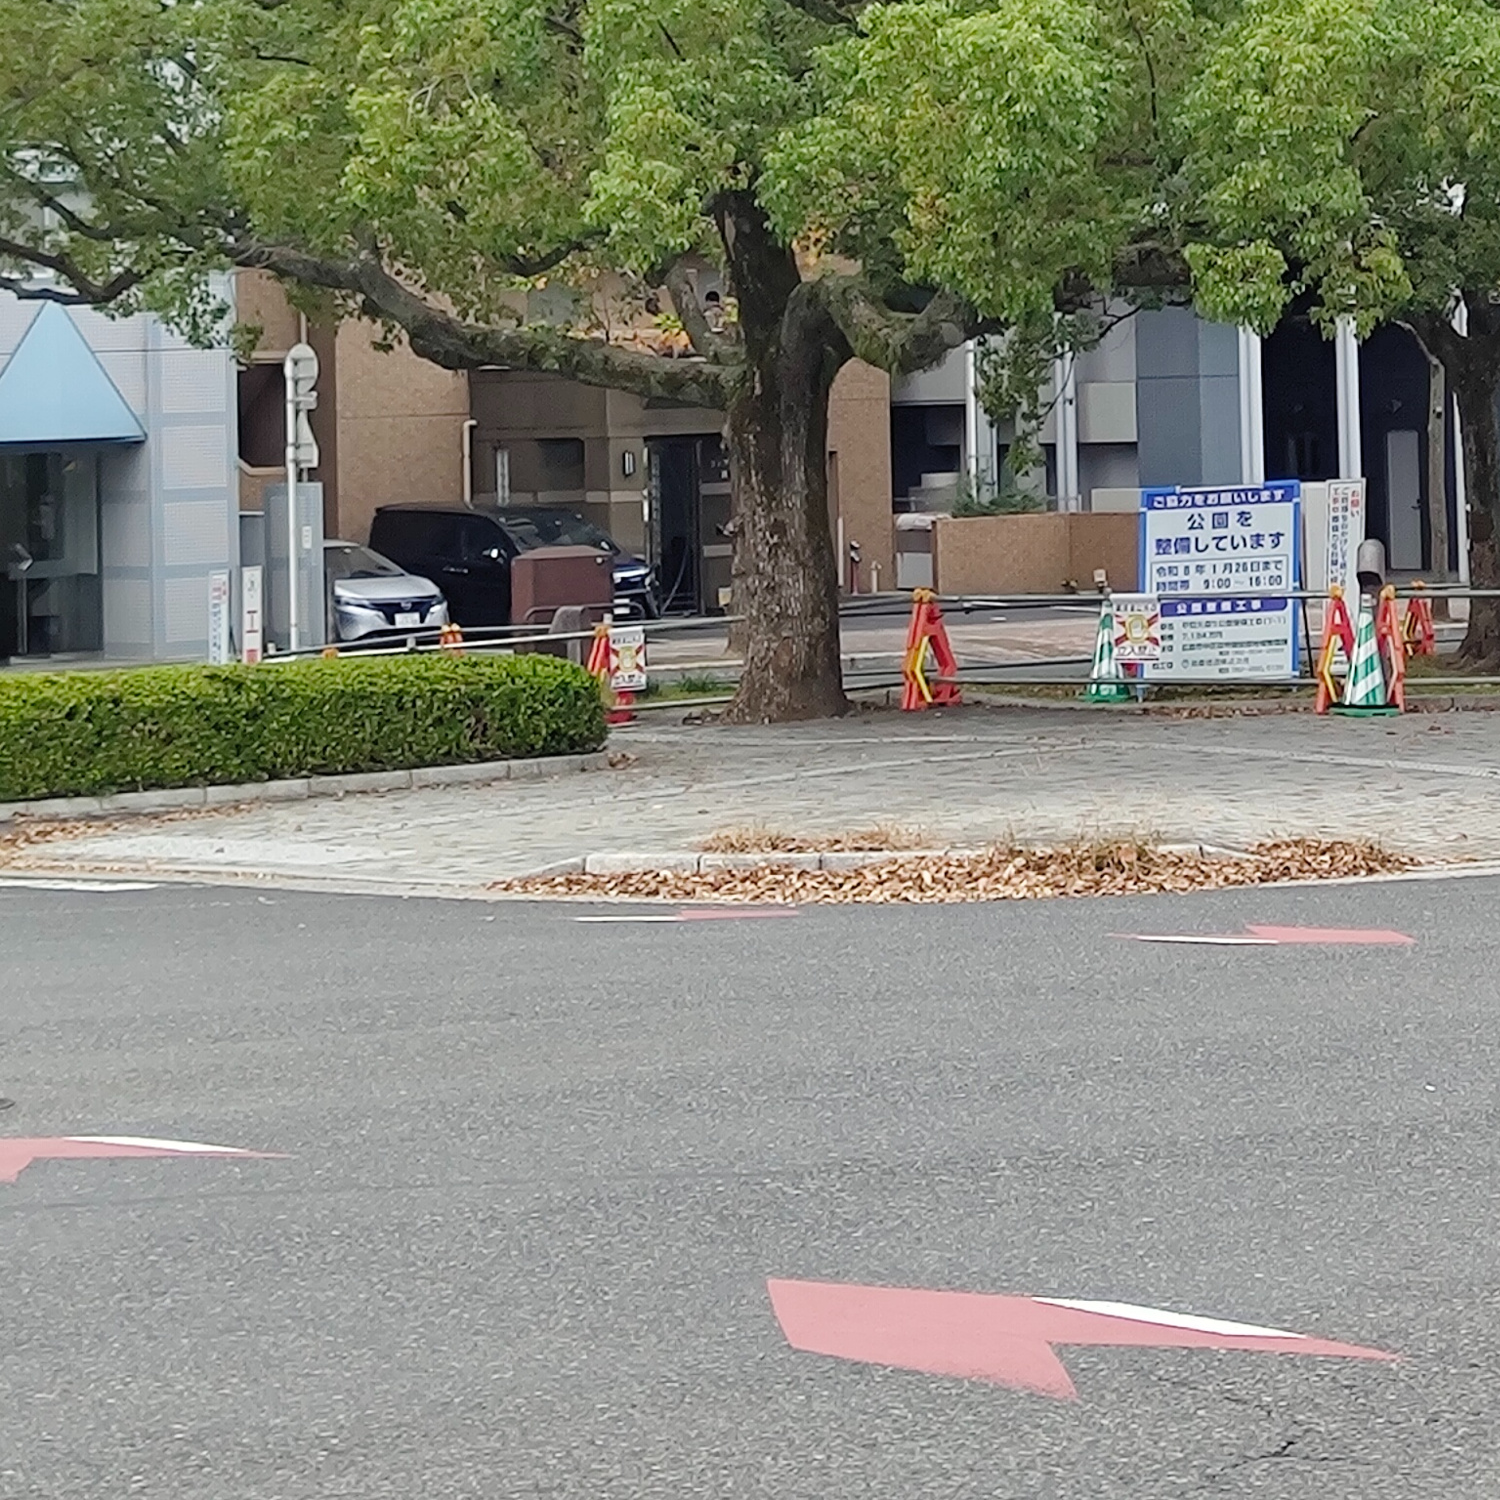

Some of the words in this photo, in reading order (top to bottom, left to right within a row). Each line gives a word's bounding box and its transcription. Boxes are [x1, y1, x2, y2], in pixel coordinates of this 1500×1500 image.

[1153, 489, 1285, 509] ご協力をお願いします
[1187, 511, 1253, 531] 公園を
[1154, 532, 1286, 556] 整備しています
